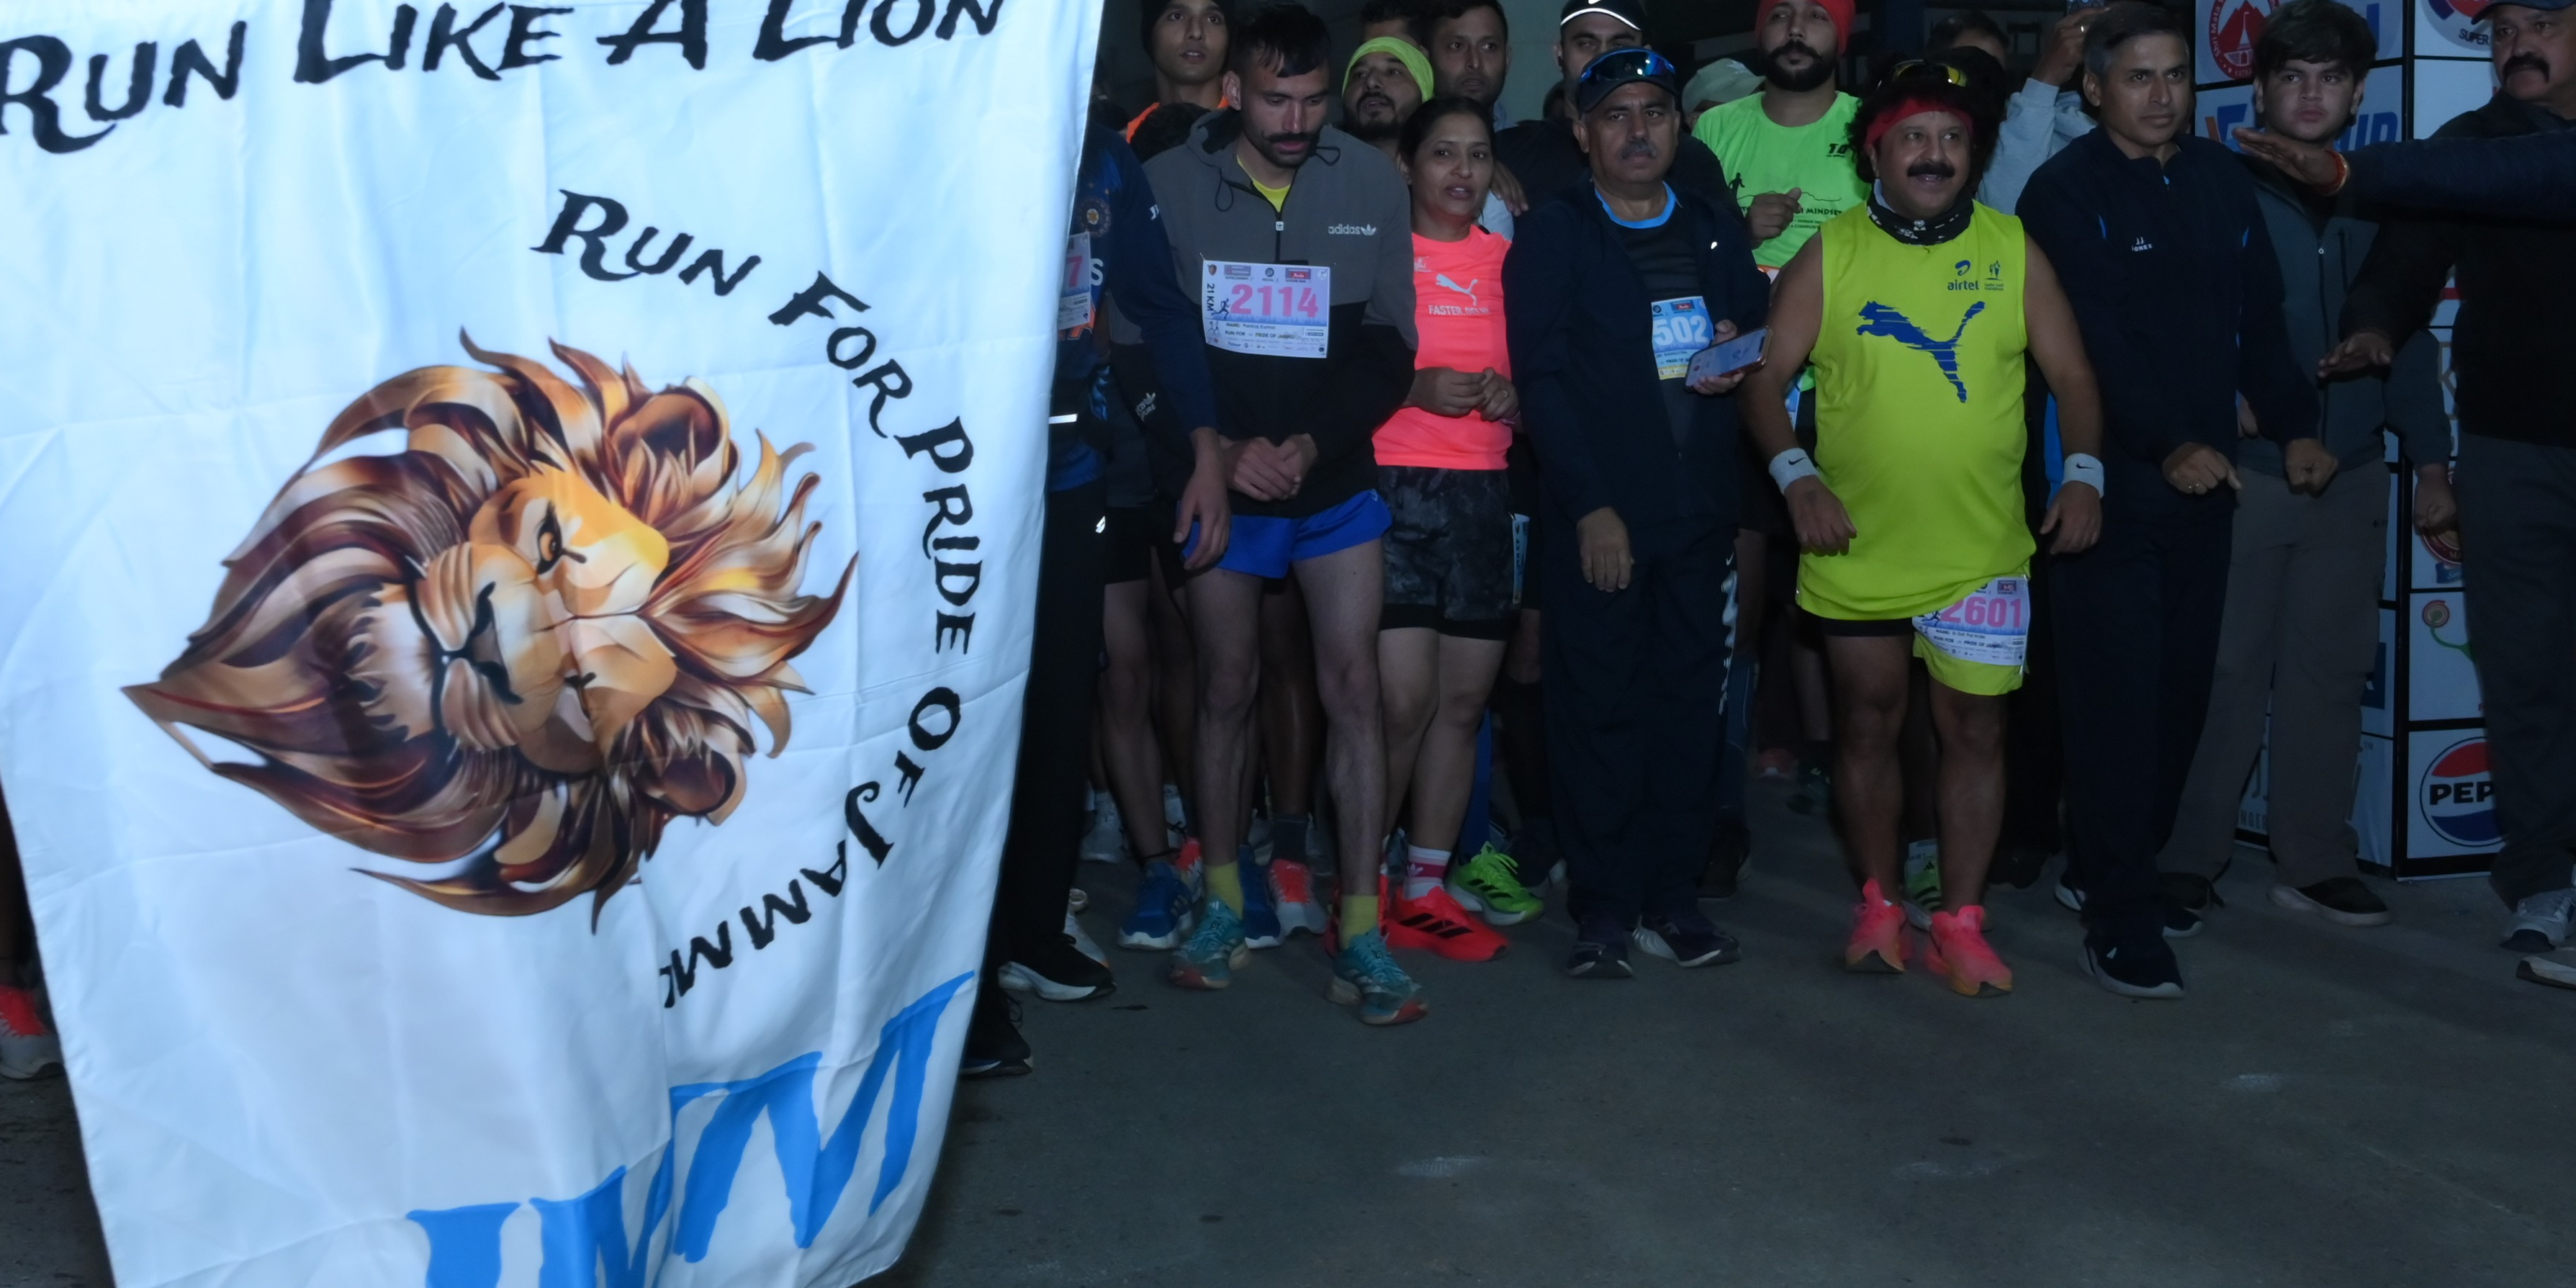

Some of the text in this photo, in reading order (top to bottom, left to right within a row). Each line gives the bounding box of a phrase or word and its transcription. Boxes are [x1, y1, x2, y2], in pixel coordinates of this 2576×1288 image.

[2459, 28, 2489, 45] SUPER
[0, 20, 247, 153] RUN
[294, 0, 575, 84] LIKE
[596, 0, 708, 71] A
[529, 189, 762, 297] RUN
[1328, 223, 1361, 235] adidas
[1207, 283, 1215, 312] 21 KM
[1947, 279, 1979, 290] airtel
[1230, 284, 1319, 318] 2114
[1653, 315, 1710, 346] 502
[767, 271, 913, 438] FOR
[893, 415, 983, 655] PRIDE
[1940, 596, 2021, 628] 2601
[894, 686, 962, 809] OF
[2430, 781, 2495, 805] PEP
